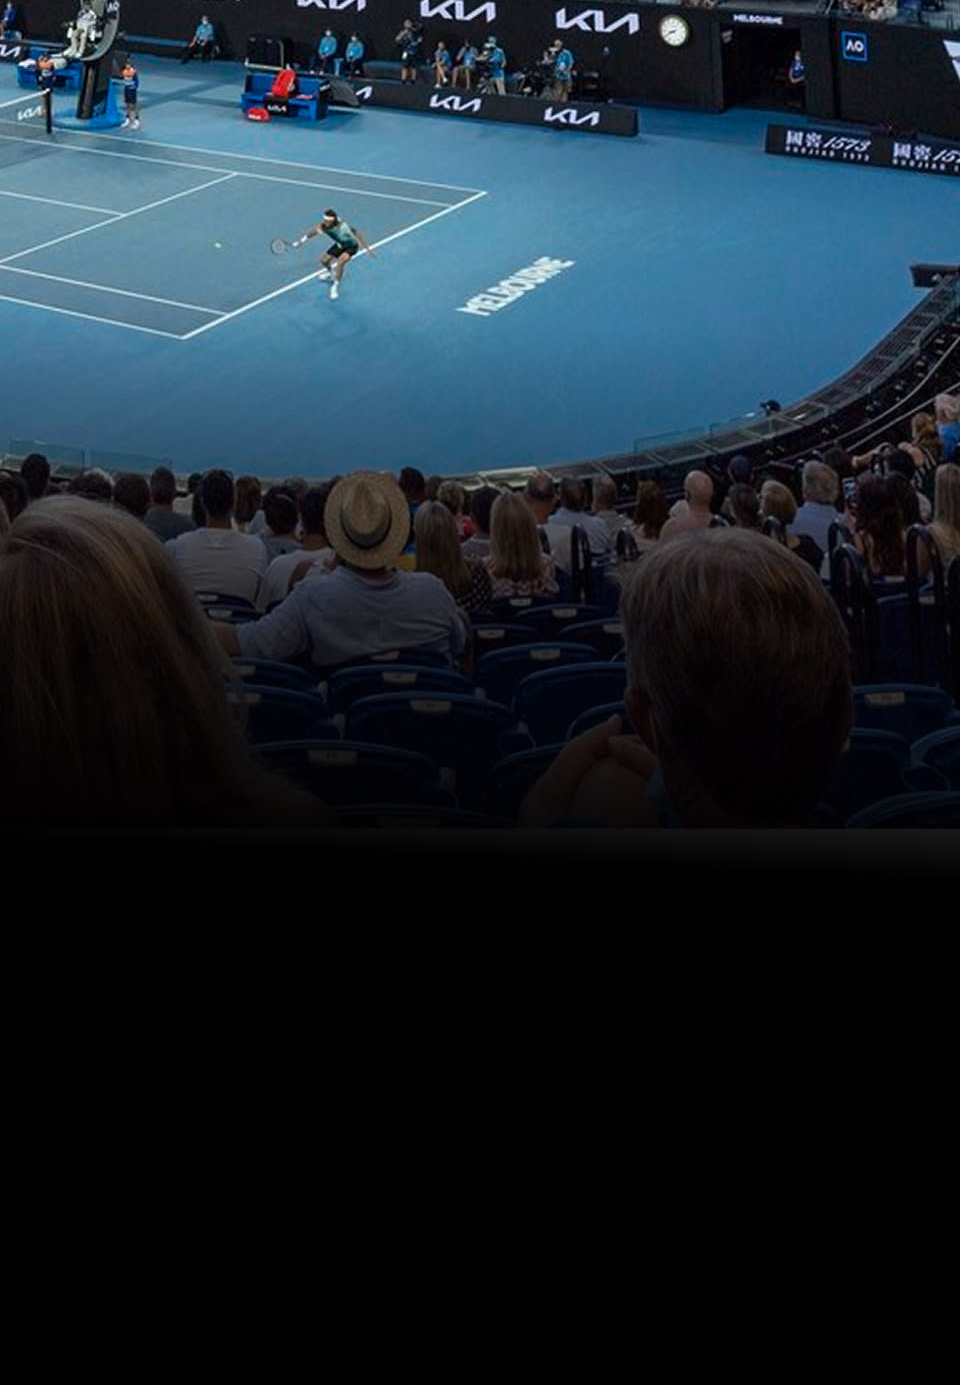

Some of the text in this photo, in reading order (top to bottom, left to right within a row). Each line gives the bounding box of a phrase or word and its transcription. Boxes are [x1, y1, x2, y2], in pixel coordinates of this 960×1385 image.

[556, 7, 640, 35] KIA
[845, 39, 865, 53] AO
[429, 92, 483, 112] KIA
[544, 106, 600, 127] KIA
[454, 256, 575, 317] MELBOURNE
